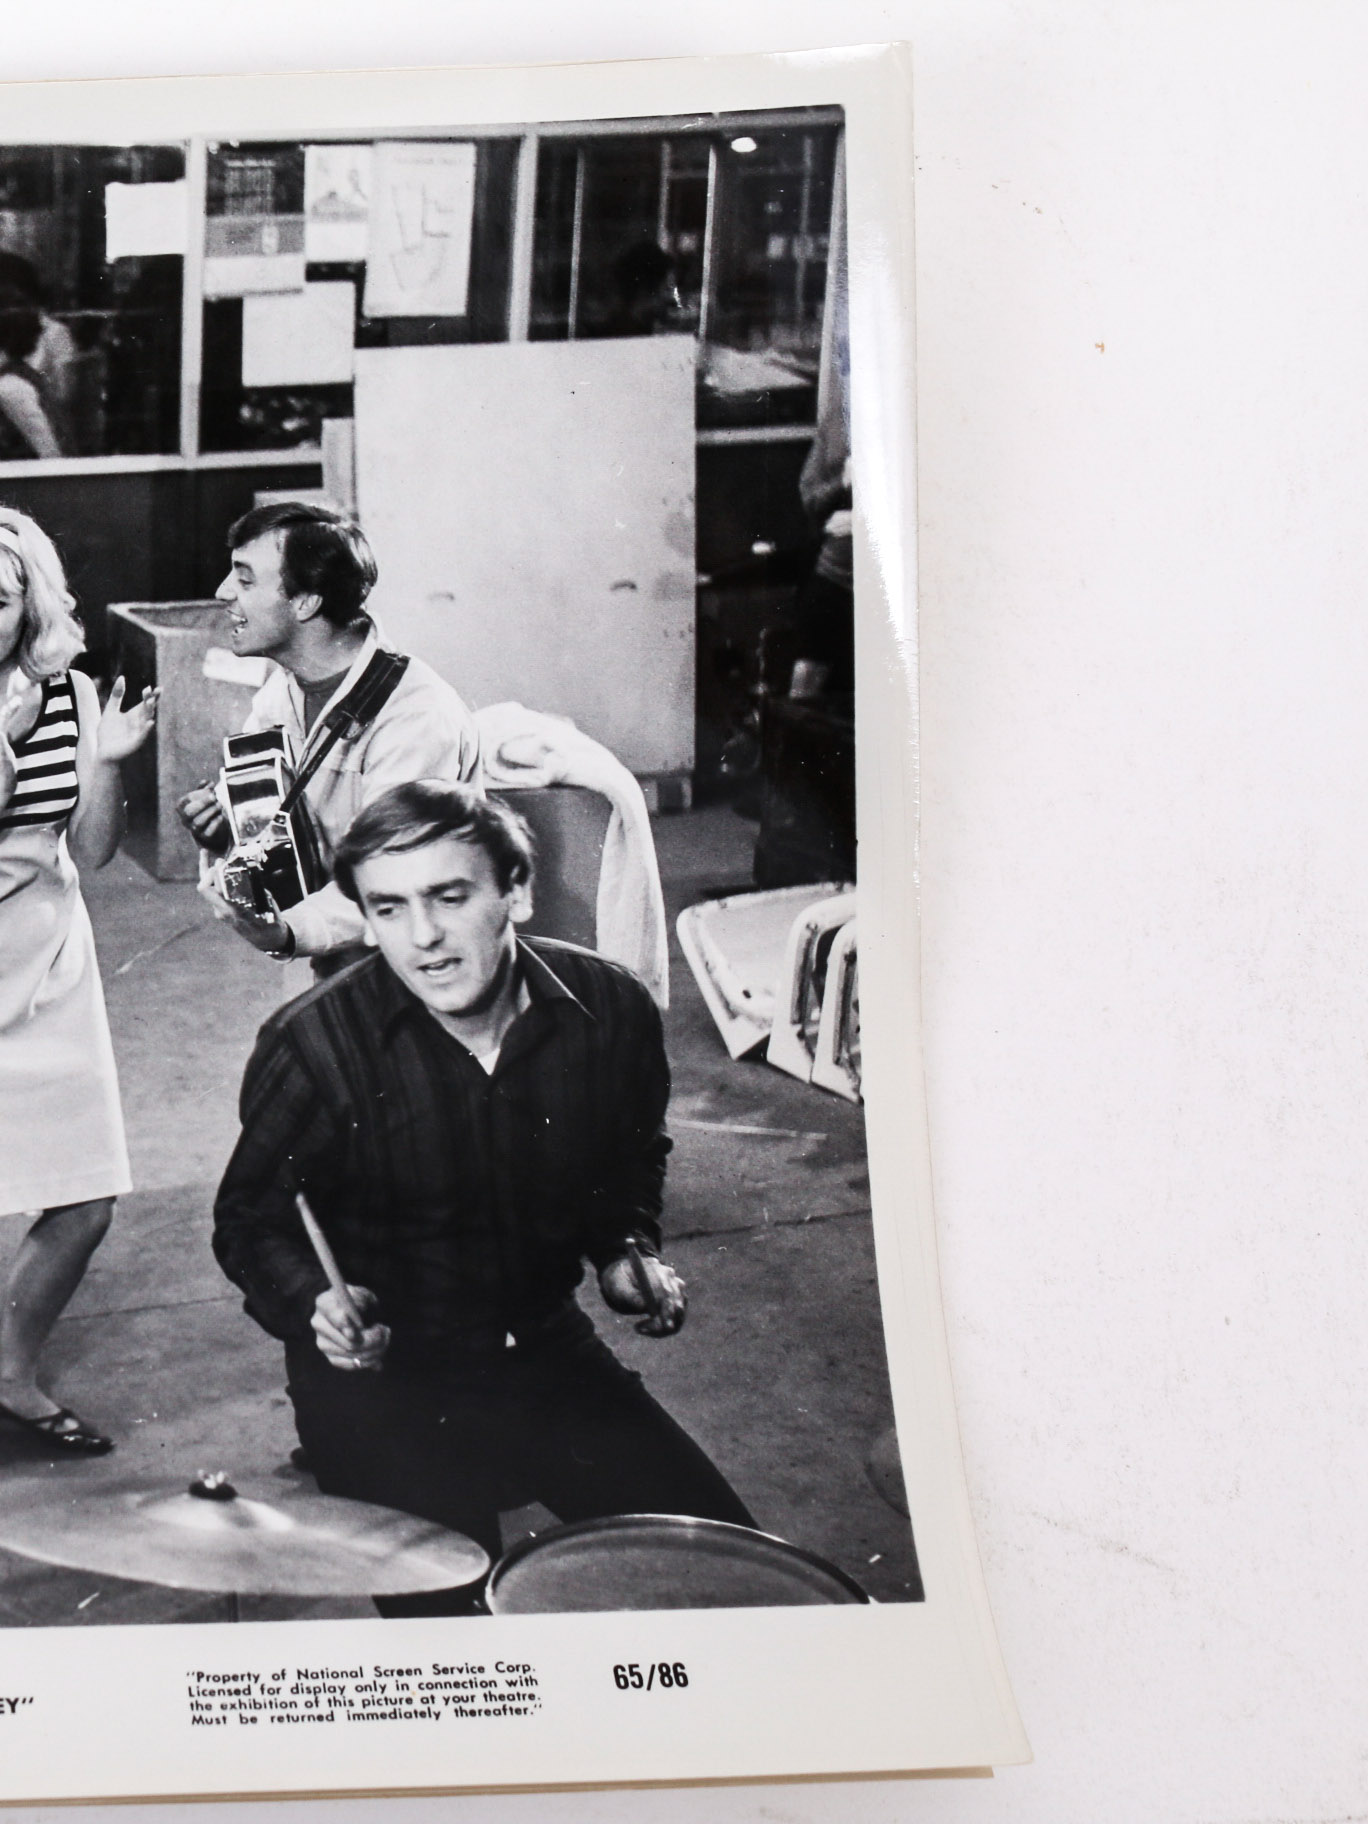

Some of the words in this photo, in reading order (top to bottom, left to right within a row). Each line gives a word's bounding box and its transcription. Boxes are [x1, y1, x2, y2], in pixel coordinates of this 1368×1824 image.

[271, 1668, 287, 1681] of
[296, 1666, 363, 1680] National
[373, 1664, 422, 1678] Screen
[431, 1662, 485, 1676] Service
[494, 1660, 536, 1676] Corp.
[612, 1661, 689, 1691] 65/86
[187, 1684, 252, 1698] Licensed
[259, 1683, 282, 1696] for
[289, 1681, 346, 1697] display
[353, 1680, 387, 1695] only
[394, 1679, 410, 1692] in
[417, 1677, 498, 1691] connection
[504, 1675, 538, 1688] with
[189, 1699, 212, 1712] the
[219, 1697, 298, 1711] exhibition
[303, 1696, 319, 1709] of
[326, 1695, 354, 1708] this
[361, 1693, 413, 1709] picture
[419, 1693, 436, 1706] at
[441, 1692, 476, 1706] your
[482, 1690, 541, 1703] theatre.
[190, 1713, 227, 1726] Must
[238, 1712, 258, 1725] be
[269, 1710, 335, 1724] returned
[346, 1707, 441, 1722] immediately
